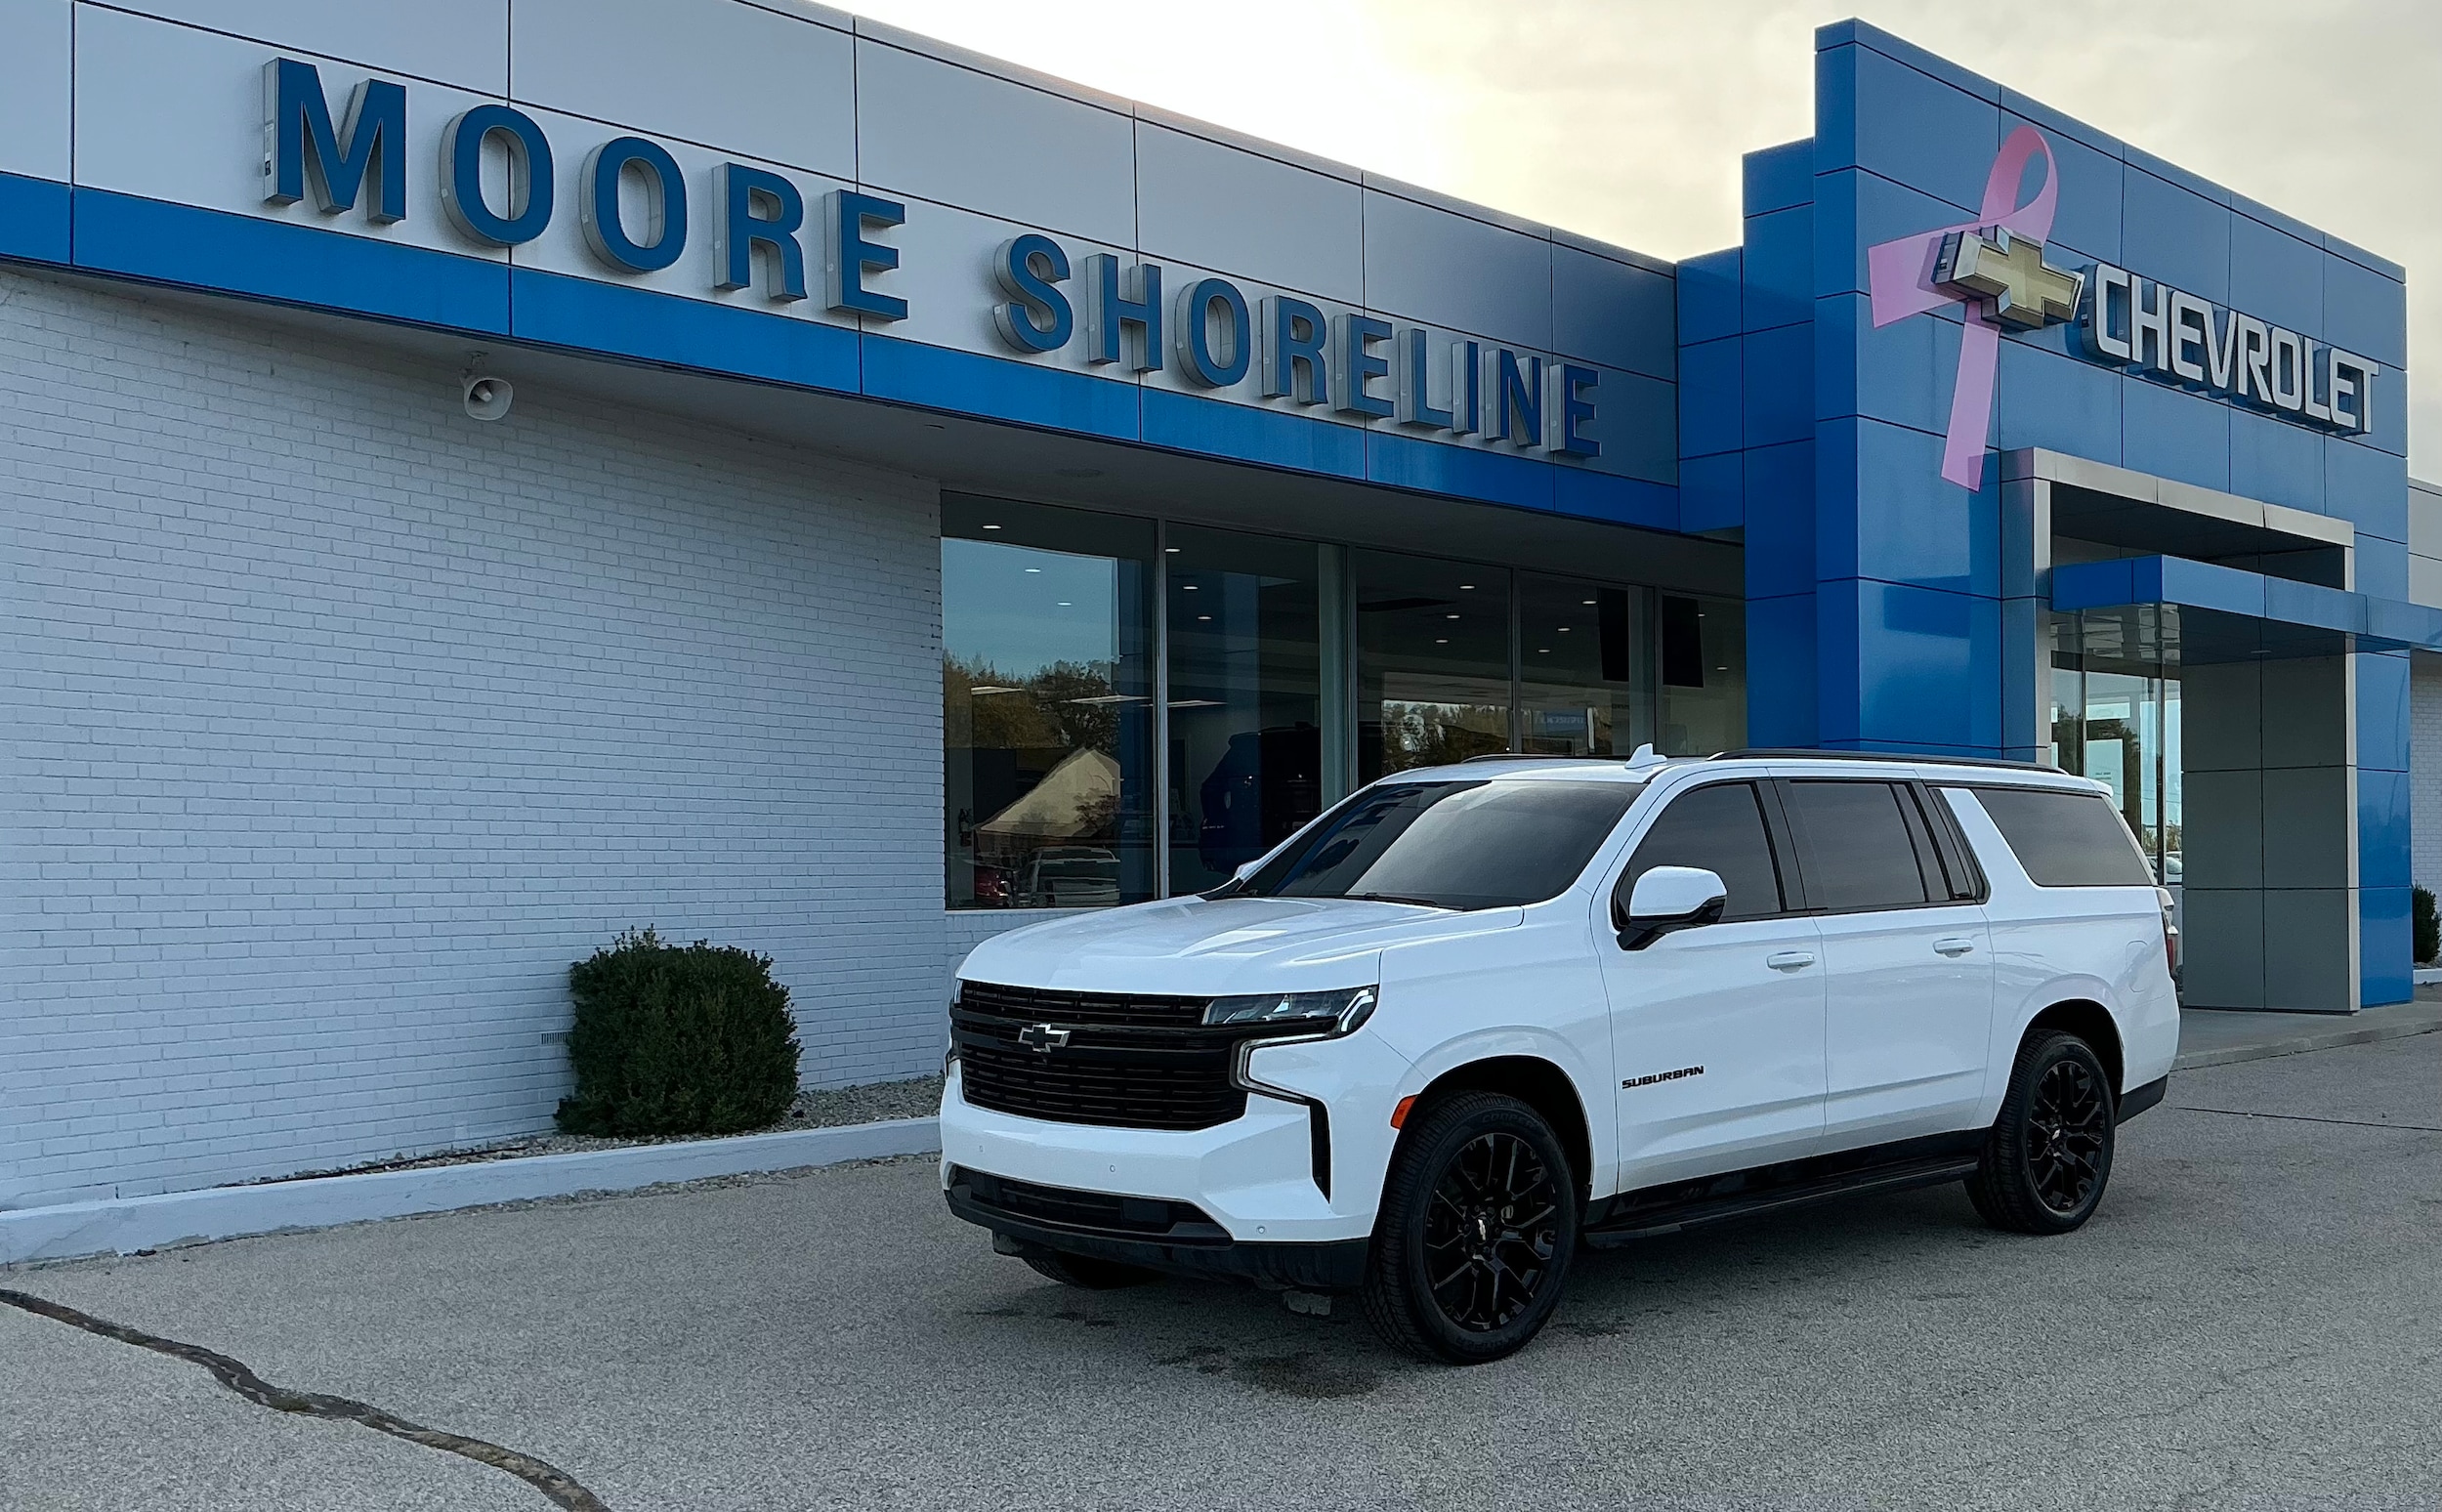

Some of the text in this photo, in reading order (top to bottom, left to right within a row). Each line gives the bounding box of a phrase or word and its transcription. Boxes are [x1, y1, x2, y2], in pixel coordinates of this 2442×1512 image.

[264, 57, 1602, 458] MOORE SHORELINE
[2090, 262, 2380, 436] CHEVROLET
[1621, 1065, 1705, 1089] SUBURBAN
